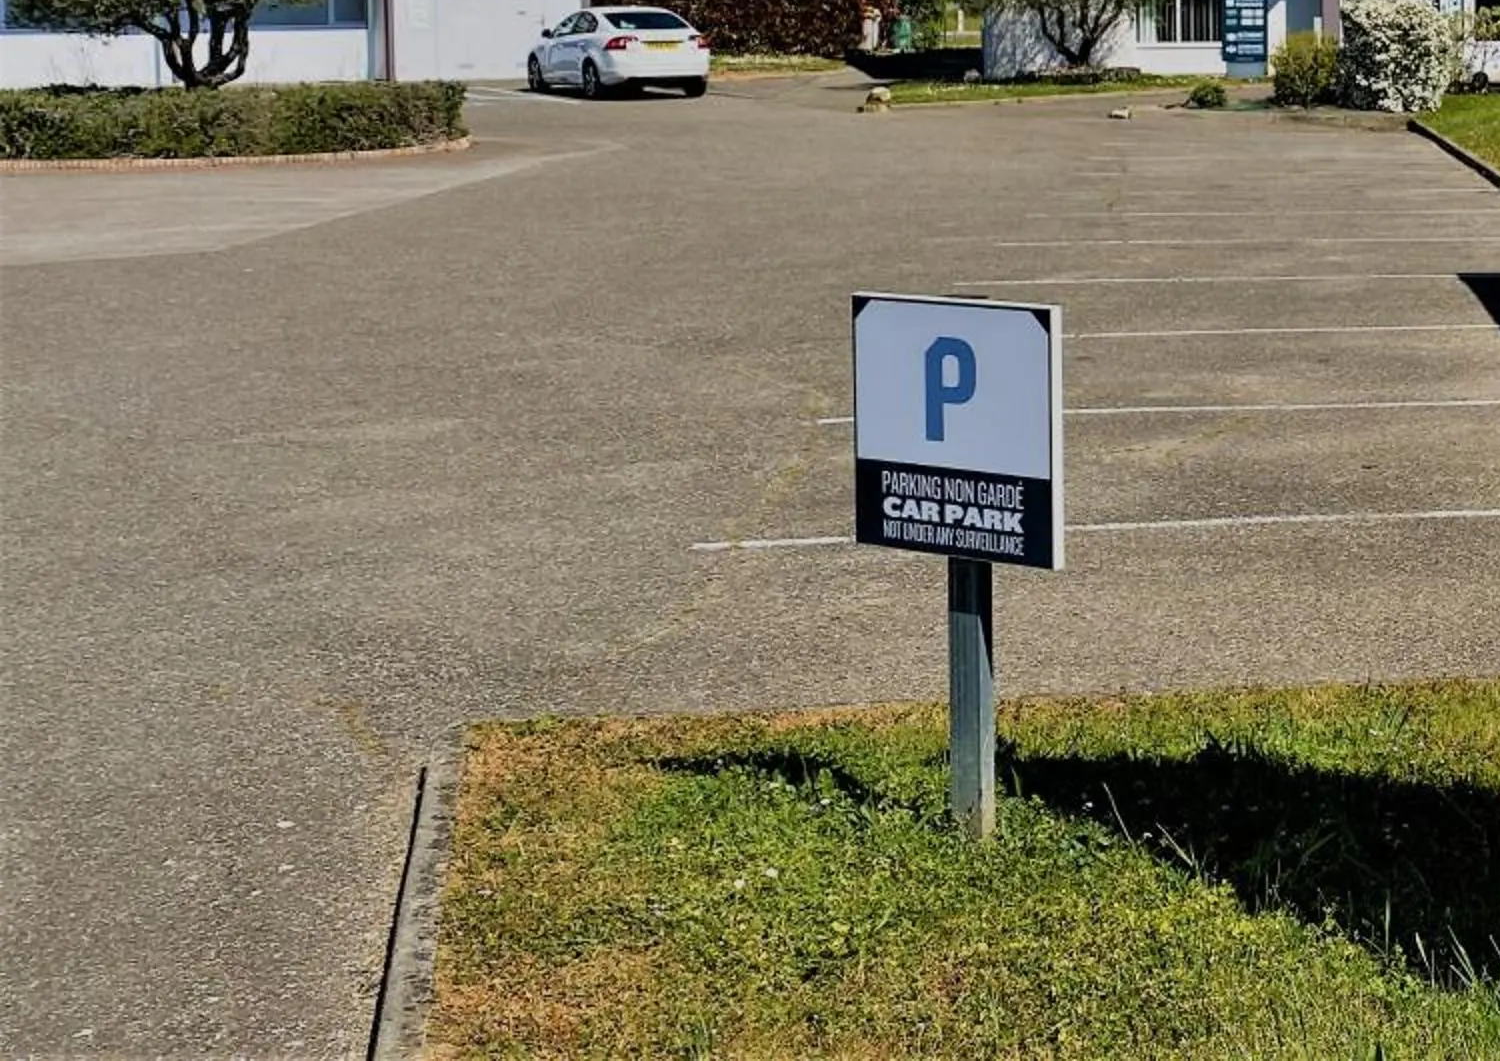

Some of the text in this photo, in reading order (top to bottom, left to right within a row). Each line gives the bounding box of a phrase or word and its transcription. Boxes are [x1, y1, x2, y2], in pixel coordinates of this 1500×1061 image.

[925, 336, 977, 442] P
[881, 470, 1025, 510] PARKING NON GARDÉ
[883, 496, 1025, 534] CAR PARK
[883, 518, 1025, 556] NOT UNDER ANY SURVEILLANCE
